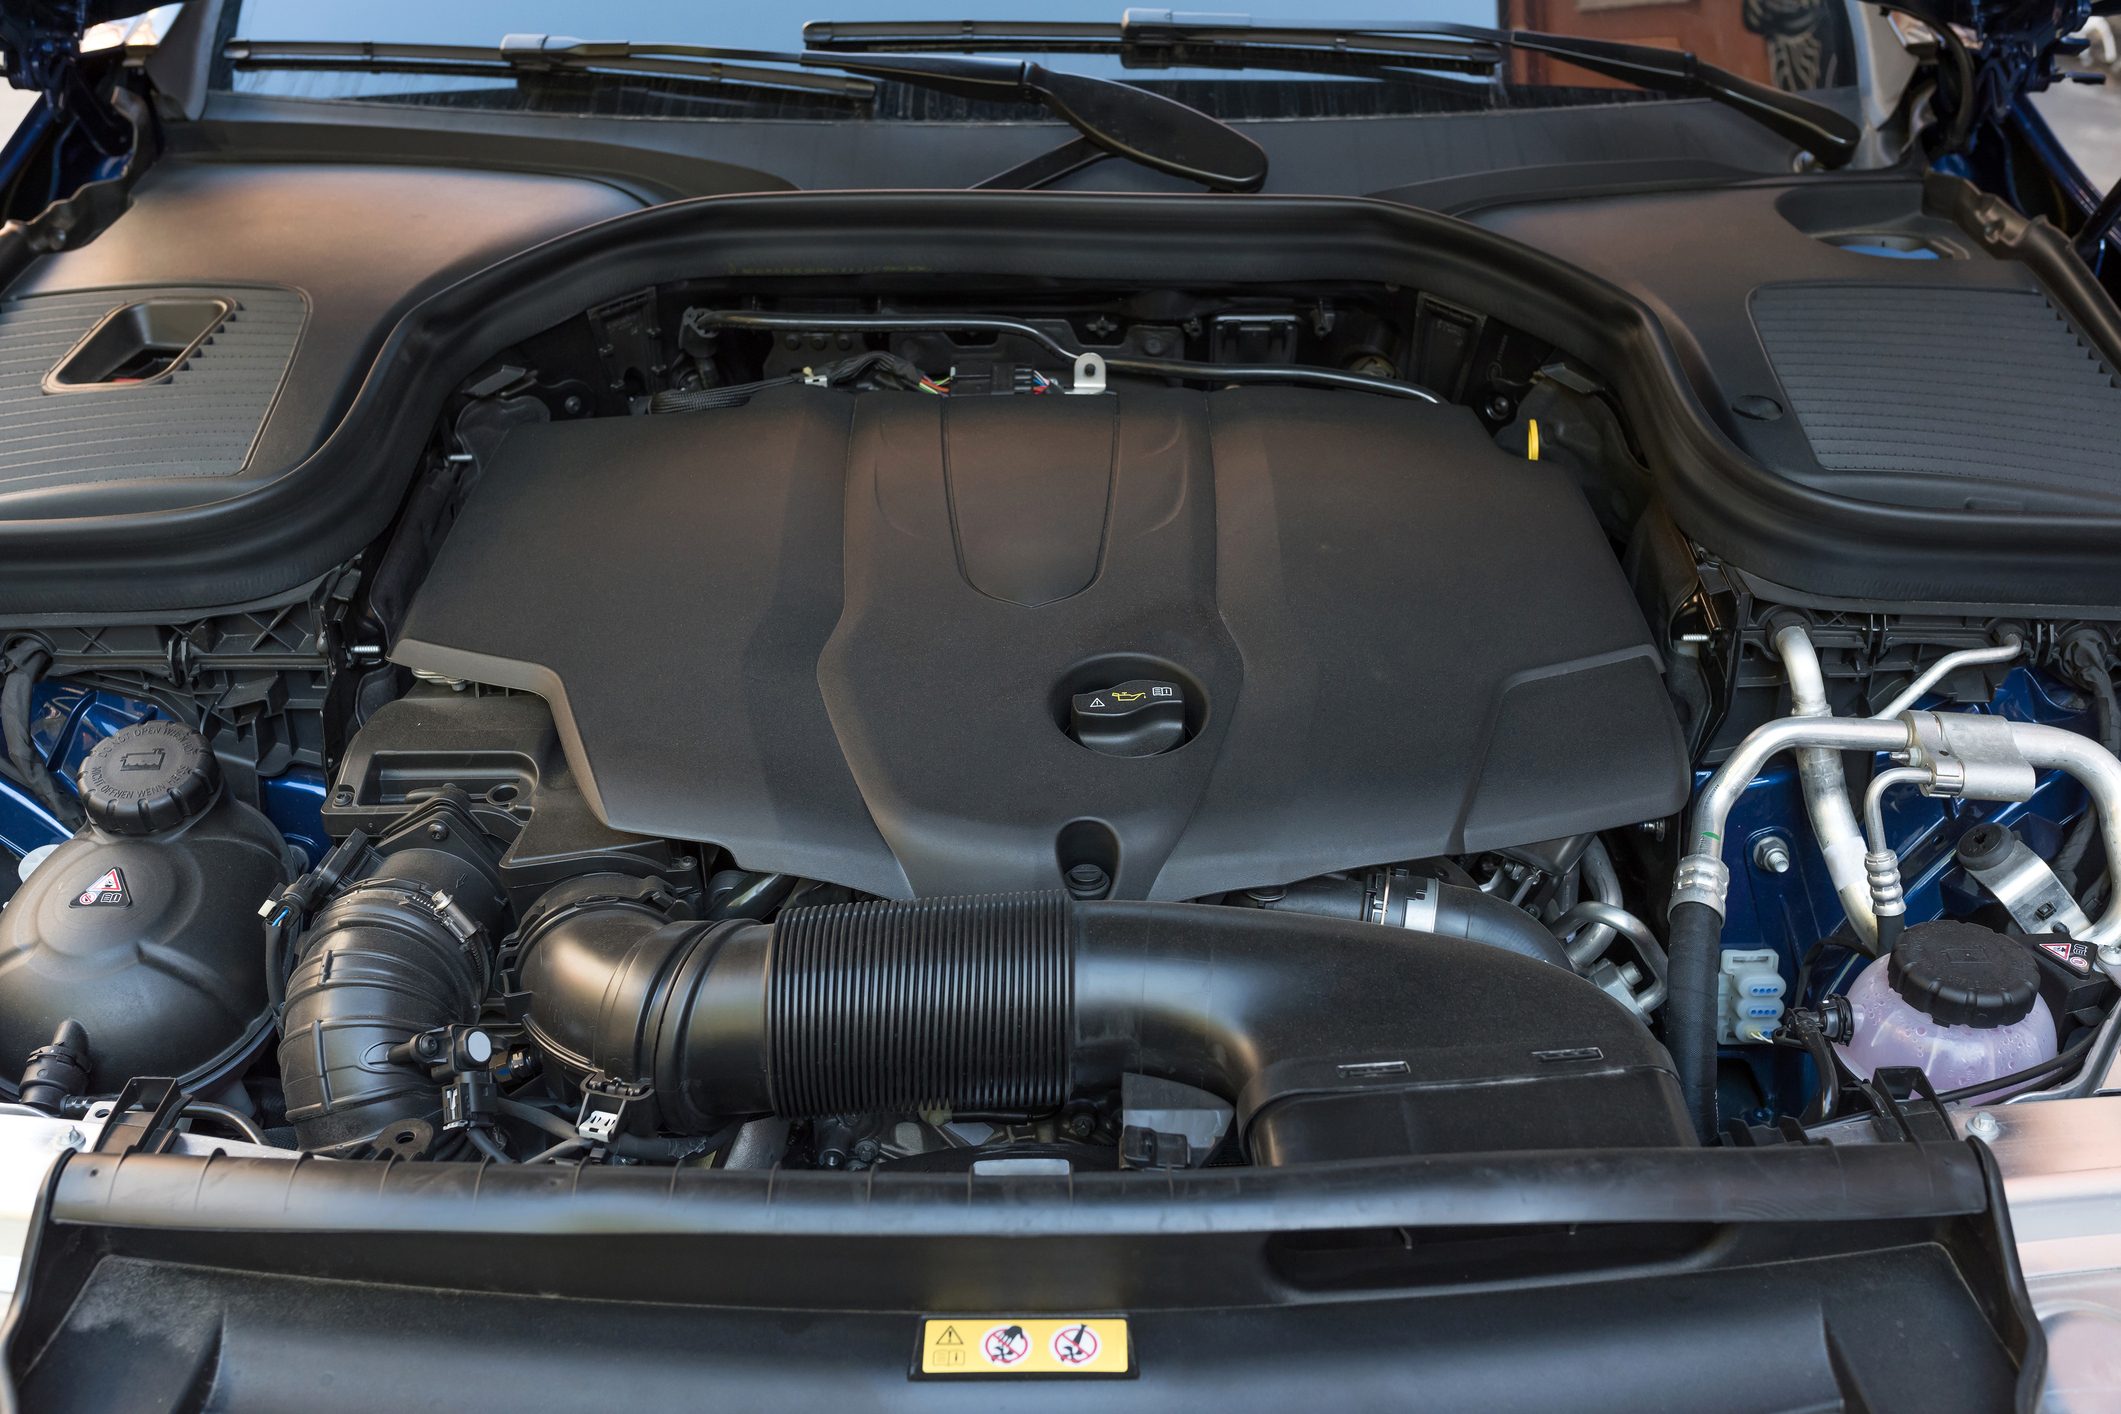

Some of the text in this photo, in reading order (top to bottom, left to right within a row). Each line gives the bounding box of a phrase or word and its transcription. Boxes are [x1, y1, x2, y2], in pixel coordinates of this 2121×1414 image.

[98, 747, 113, 759] DO
[111, 732, 130, 745] NOT
[134, 726, 161, 737] OPEN
[163, 727, 188, 743] WHEN
[137, 783, 166, 798] WENN
